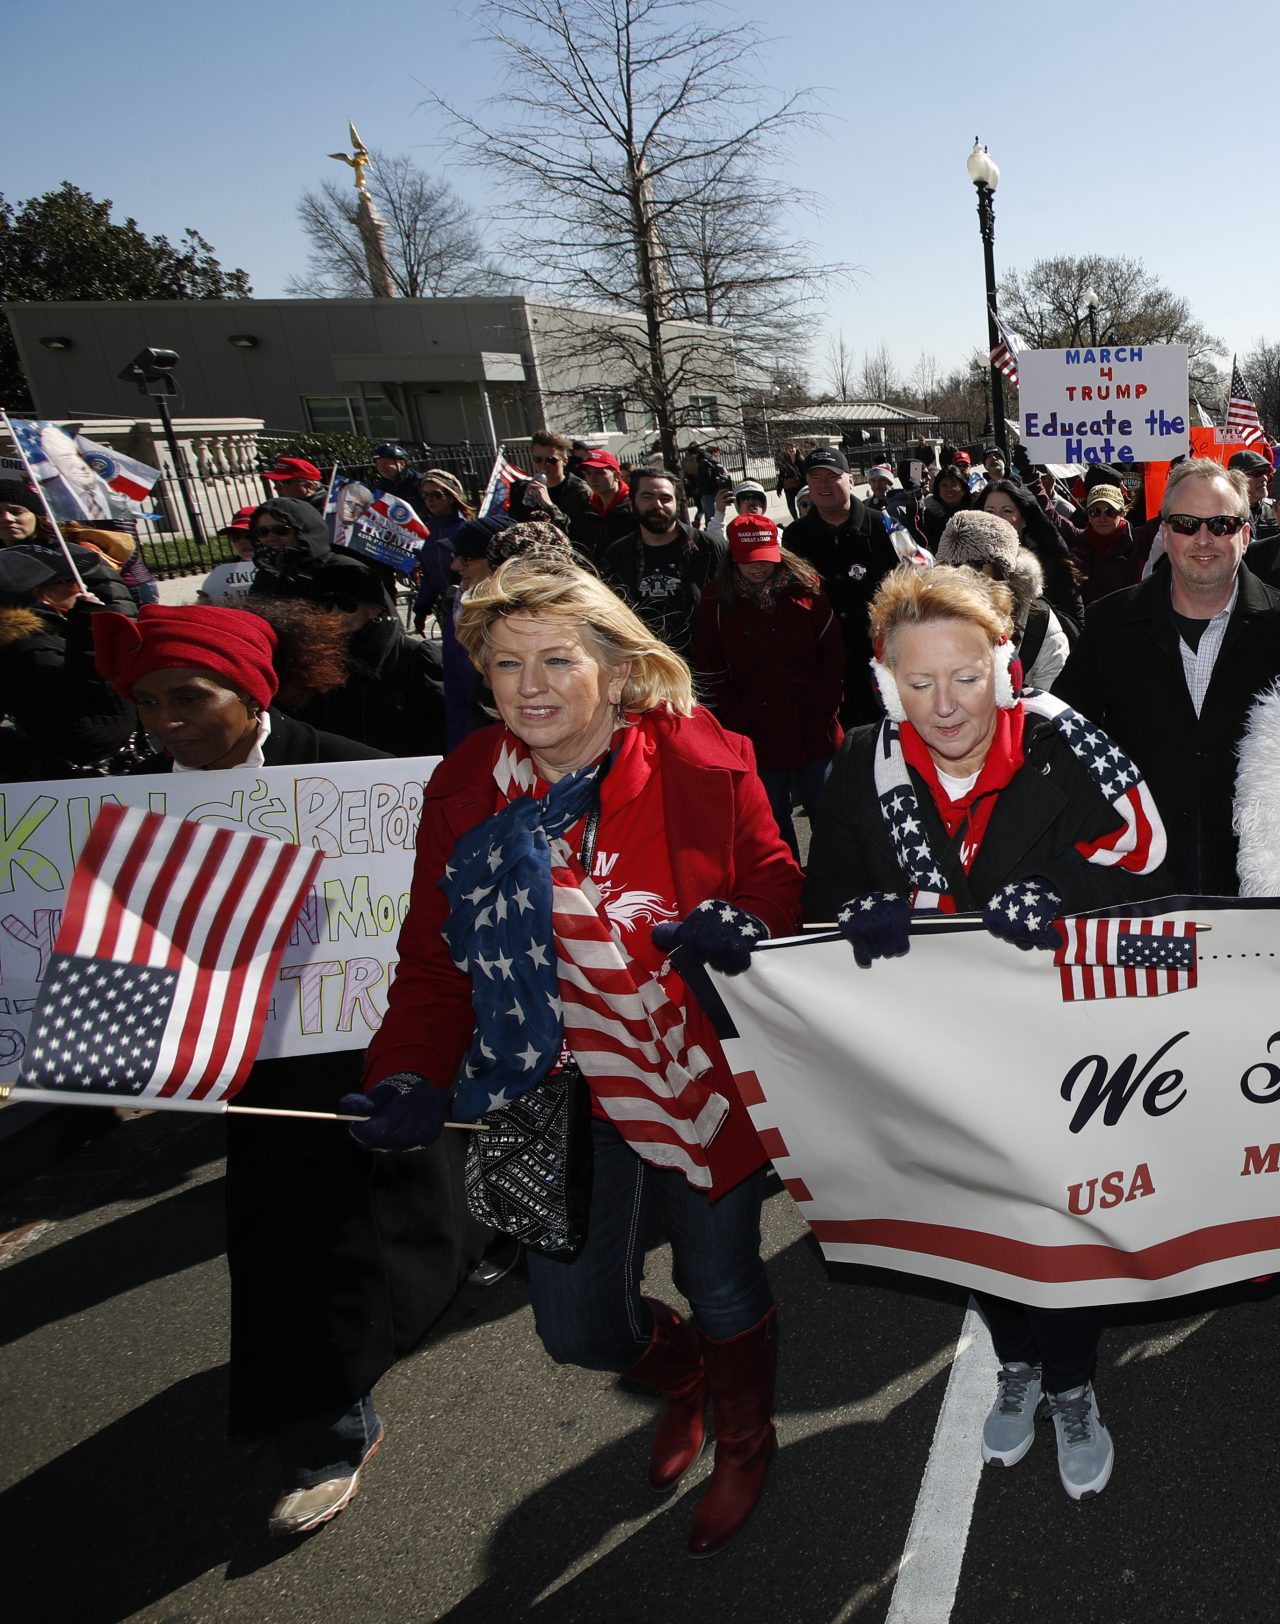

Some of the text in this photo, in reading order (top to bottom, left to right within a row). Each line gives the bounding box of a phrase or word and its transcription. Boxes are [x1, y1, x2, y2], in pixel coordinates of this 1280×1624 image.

[1066, 347, 1143, 364] MARCH
[1100, 367, 1113, 381] 4
[1066, 384, 1148, 401] TRUMP
[1025, 409, 1185, 437] Educate the
[1066, 438, 1135, 463] Hate
[1, 459, 28, 471] ONL
[360, 521, 418, 552] TRUMP
[1060, 1030, 1190, 1134] We
[1067, 1161, 1156, 1216] USA
